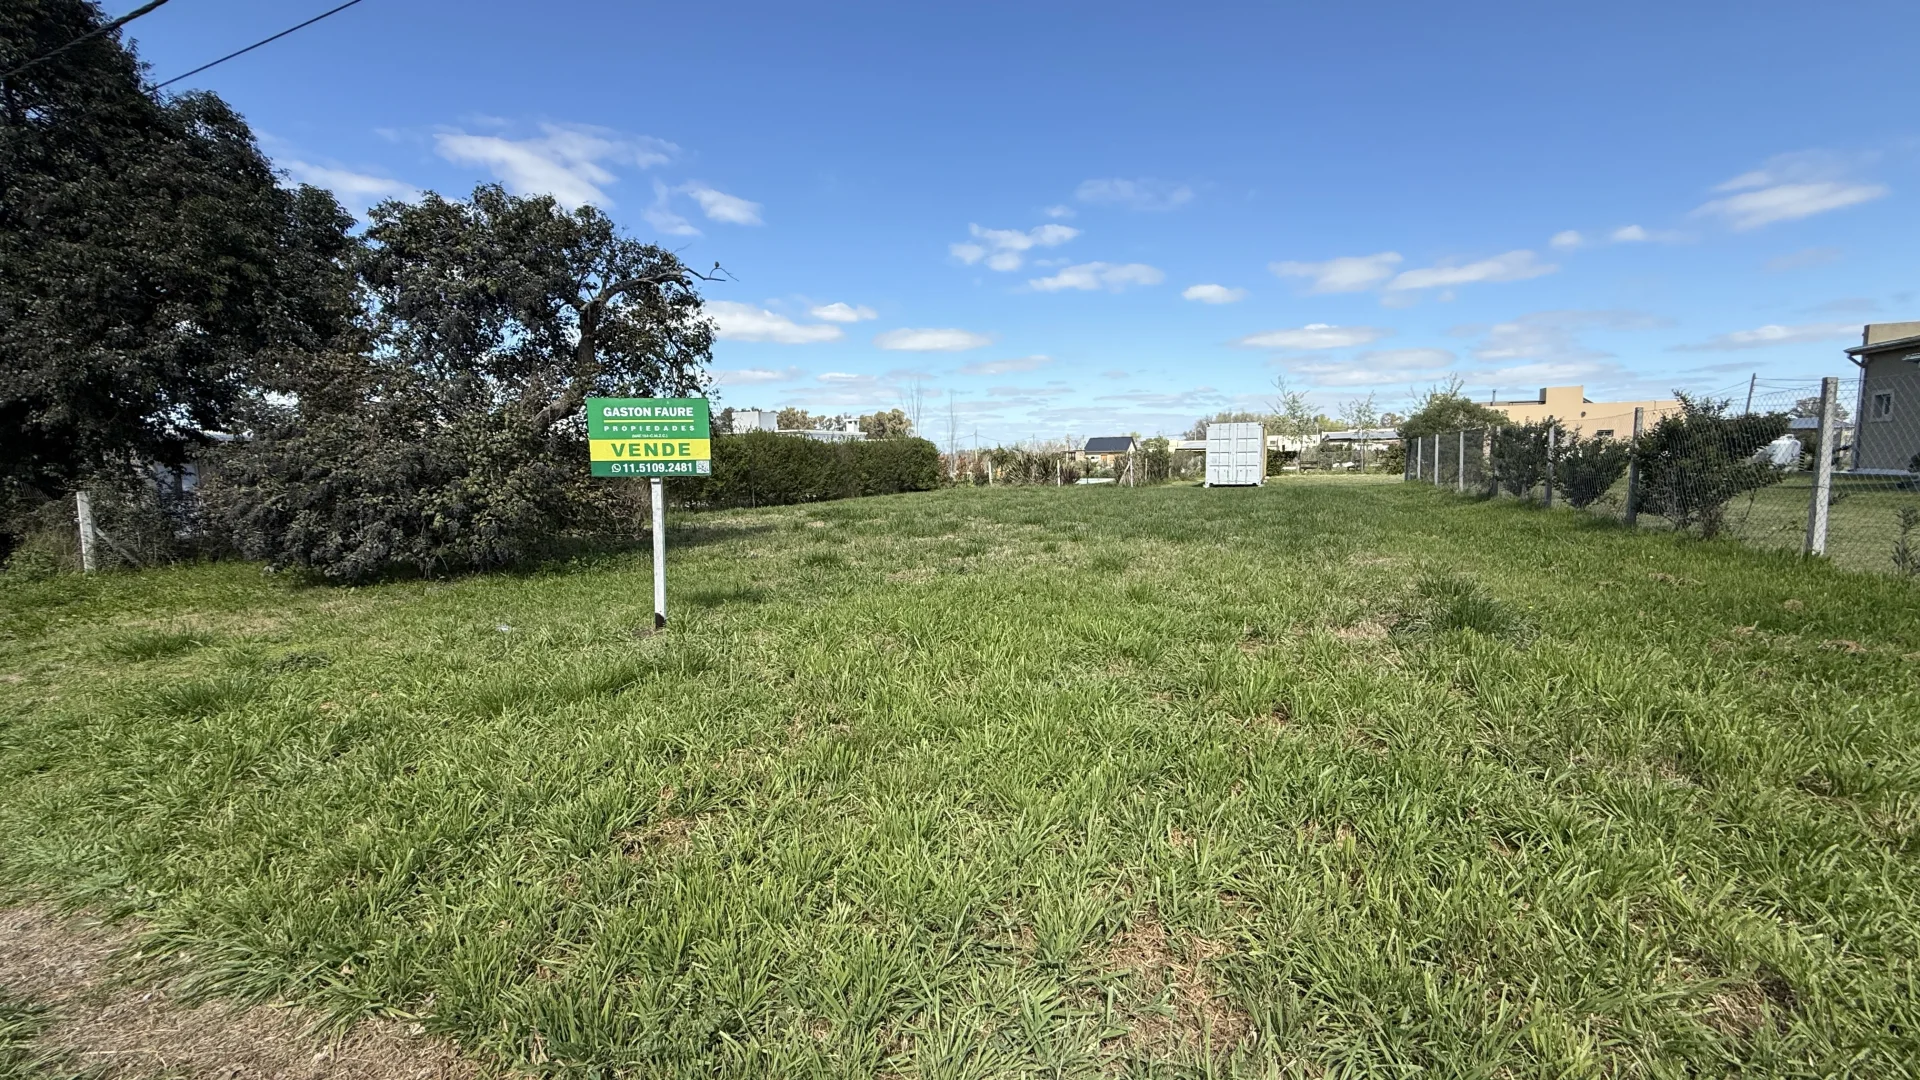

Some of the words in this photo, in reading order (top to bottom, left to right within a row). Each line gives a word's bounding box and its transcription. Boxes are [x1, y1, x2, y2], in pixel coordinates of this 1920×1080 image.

[603, 407, 652, 417] GASTON
[655, 407, 693, 417] FAURE
[611, 442, 691, 457] VENDE
[623, 462, 693, 473] 11.5109.2481
